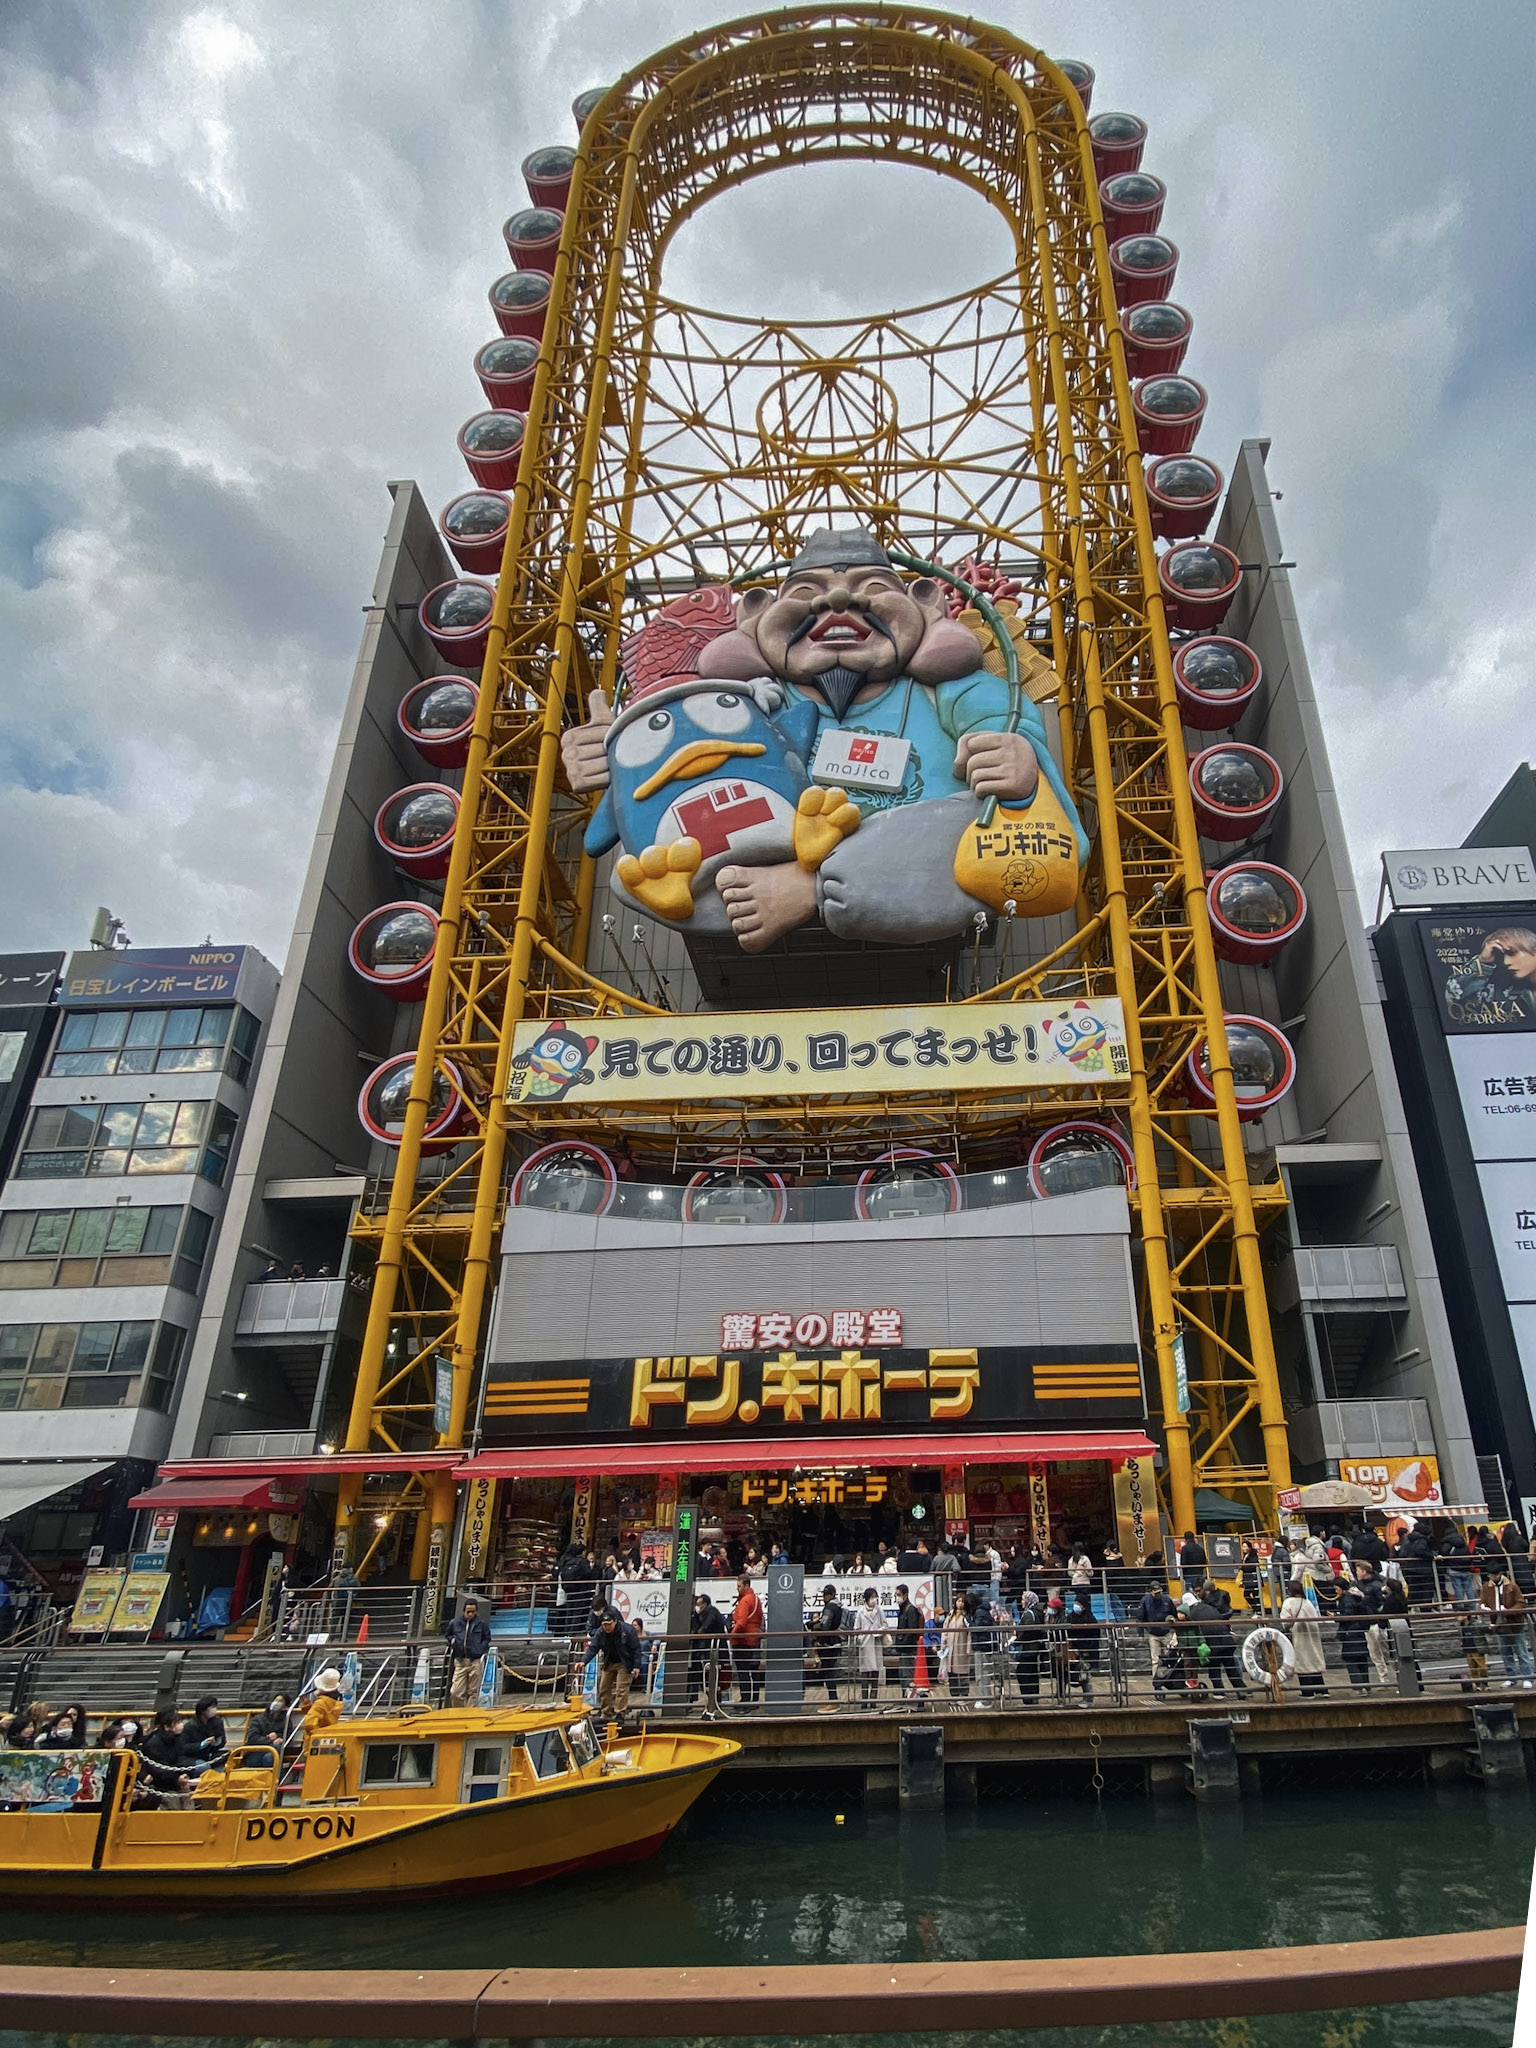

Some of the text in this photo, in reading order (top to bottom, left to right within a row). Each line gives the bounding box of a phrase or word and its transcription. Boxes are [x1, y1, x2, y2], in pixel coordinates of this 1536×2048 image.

[1432, 863, 1530, 886] BRAVE
[189, 953, 236, 965] NIPPO
[68, 975, 229, 997] 日宝レインボービル
[1447, 1001, 1526, 1021] OSAKA
[1110, 1044, 1130, 1074] 開運
[505, 1070, 527, 1101] 招福
[721, 1310, 903, 1350] 驚安の殿堂
[1346, 1465, 1391, 1485] 10円
[246, 1815, 357, 1841] DOTON
